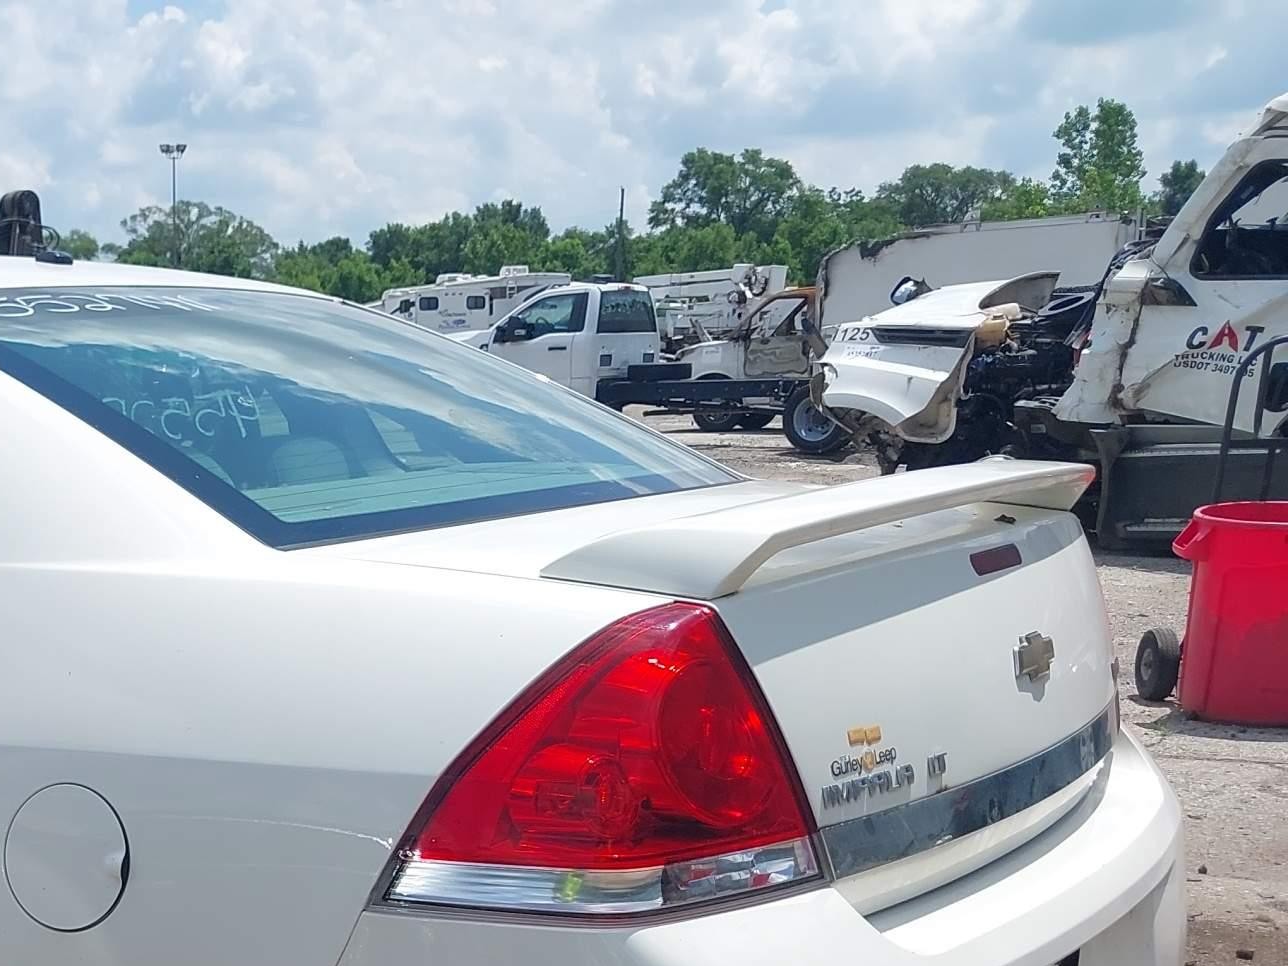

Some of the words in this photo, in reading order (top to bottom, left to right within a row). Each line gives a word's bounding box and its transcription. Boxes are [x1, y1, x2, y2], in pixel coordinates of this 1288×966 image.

[1185, 319, 1265, 353] CAT
[1173, 360, 1210, 370] USDOT
[1174, 351, 1235, 364] TRUCKING
[874, 746, 897, 766] Leep
